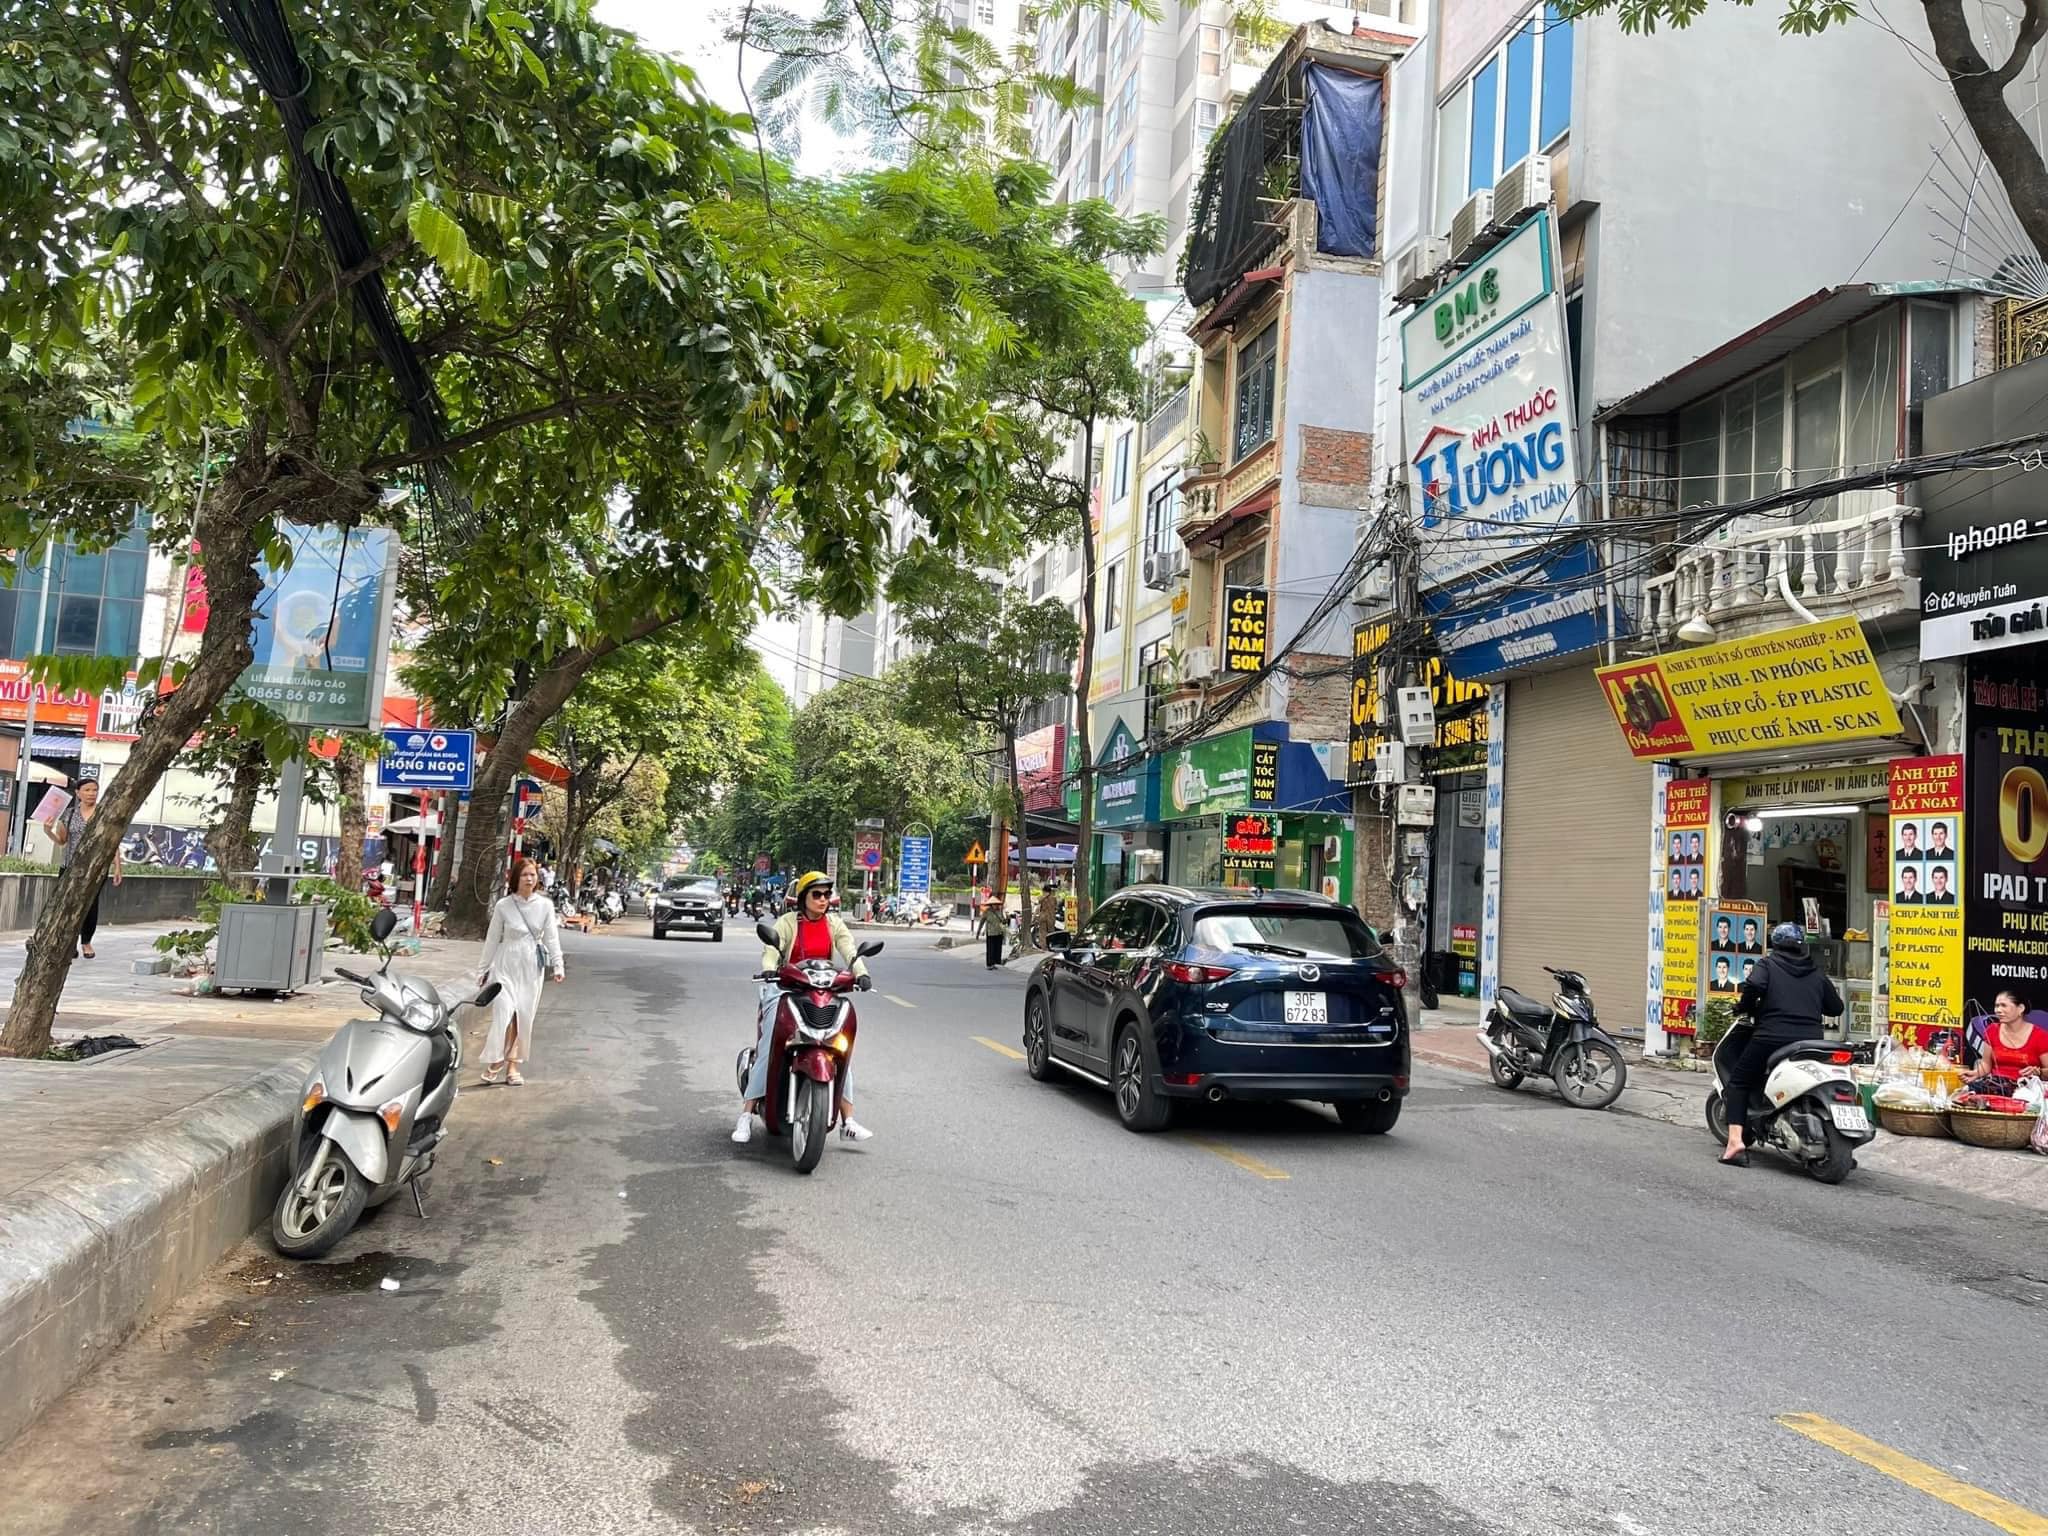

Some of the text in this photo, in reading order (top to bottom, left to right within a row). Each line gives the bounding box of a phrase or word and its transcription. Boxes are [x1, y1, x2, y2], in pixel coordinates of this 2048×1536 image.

[1472, 386, 1557, 450] NHÀ THUỐC
[1416, 422, 1565, 528] HƯƠNG
[1232, 592, 1265, 614] CẮT
[1941, 583, 2017, 610] 62 Nguyễn Tuân
[1230, 616, 1265, 635] TÓC
[1970, 603, 2043, 641] TÁO GIÁ
[1228, 636, 1265, 653] NAM
[1700, 651, 1730, 667] THUẬT
[1732, 647, 1743, 661] SỐ
[1744, 640, 1785, 658] CHUYÊN
[1786, 632, 1826, 651] NGHIỆP
[1836, 626, 1857, 641] ATV
[1231, 655, 1261, 671] 50K
[1672, 649, 1870, 697] CHỤP ẢNH IN PHÓNG ẢNH
[324, 676, 346, 689] CÁO
[248, 685, 346, 704] 0865 86 87 86
[1692, 680, 1873, 721] ẢNH ÉP GỖ ÉP PLASTIC
[1709, 711, 1882, 747] PHỤC CHẾ ẢNH SCAN
[1628, 729, 1650, 749] 64
[385, 757, 465, 774] HỒNG NGỌC
[1256, 752, 1274, 765] CẮT
[1255, 766, 1274, 776] TÓC
[1893, 762, 1958, 781] ẢNH THẺ
[1254, 778, 1274, 788] NAM
[1668, 783, 1708, 800] ẢNH THẺ
[1745, 780, 1763, 798] ẢNH
[1765, 777, 1780, 795] THẺ
[1783, 776, 1799, 795] LẤY
[1801, 778, 1826, 793] NGAY
[1835, 776, 1845, 790] IN
[1848, 770, 1868, 790] ẢNH
[1897, 779, 1949, 796] 5 PHÚT
[1255, 790, 1272, 799] 50K
[1891, 795, 1959, 810] LẤY NGAY
[1670, 798, 1702, 811] 5 PHÚT
[1236, 815, 1262, 834] CẮT
[1667, 809, 1708, 823] LẤY NGAY
[1260, 861, 1273, 869] TAI
[1983, 873, 2028, 902] IPAD
[1896, 908, 1960, 920] CHỤP ẢNH THẺ
[1896, 926, 1958, 937] IN PHÓNG ẢNH
[2002, 911, 2048, 935] PHỤ KIỆ
[1896, 944, 1944, 954] ÉP PLASTIC
[1896, 961, 1930, 970] SCAN A4
[1991, 964, 2039, 979] HOTLINE:
[1896, 975, 1942, 988] ẢNH ÉP GỖ
[1295, 992, 1316, 1006] 30F
[1664, 998, 1680, 1017] 64
[1896, 995, 1948, 1006] KHUNG ẢNH
[1920, 1011, 1940, 1023] CHẾ
[1941, 1012, 1960, 1025] ẢNH
[1891, 1023, 1918, 1047] 64
